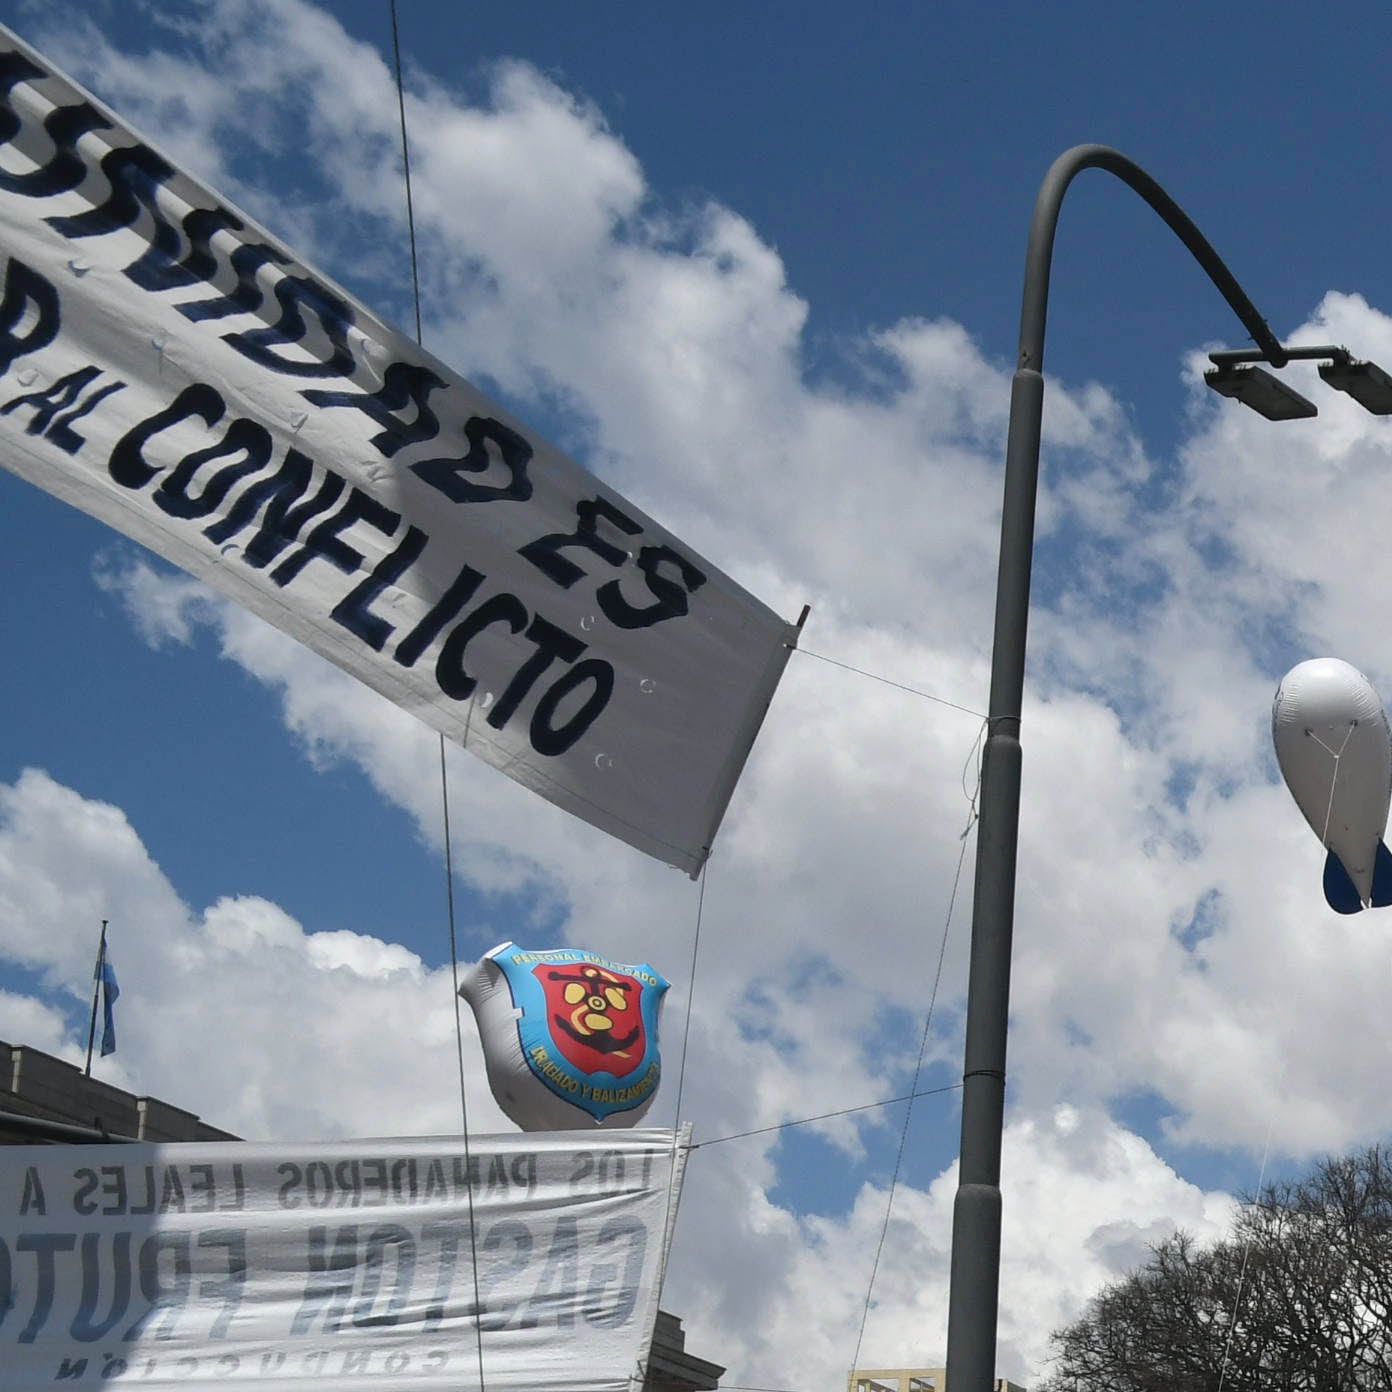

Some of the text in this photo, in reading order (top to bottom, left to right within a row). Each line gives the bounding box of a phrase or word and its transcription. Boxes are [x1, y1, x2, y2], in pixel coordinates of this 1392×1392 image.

[3, 366, 615, 758] AL CONFLICTO
[518, 494, 706, 629] ES
[512, 953, 581, 966] PERSONAL
[580, 1086, 591, 1099] Y
